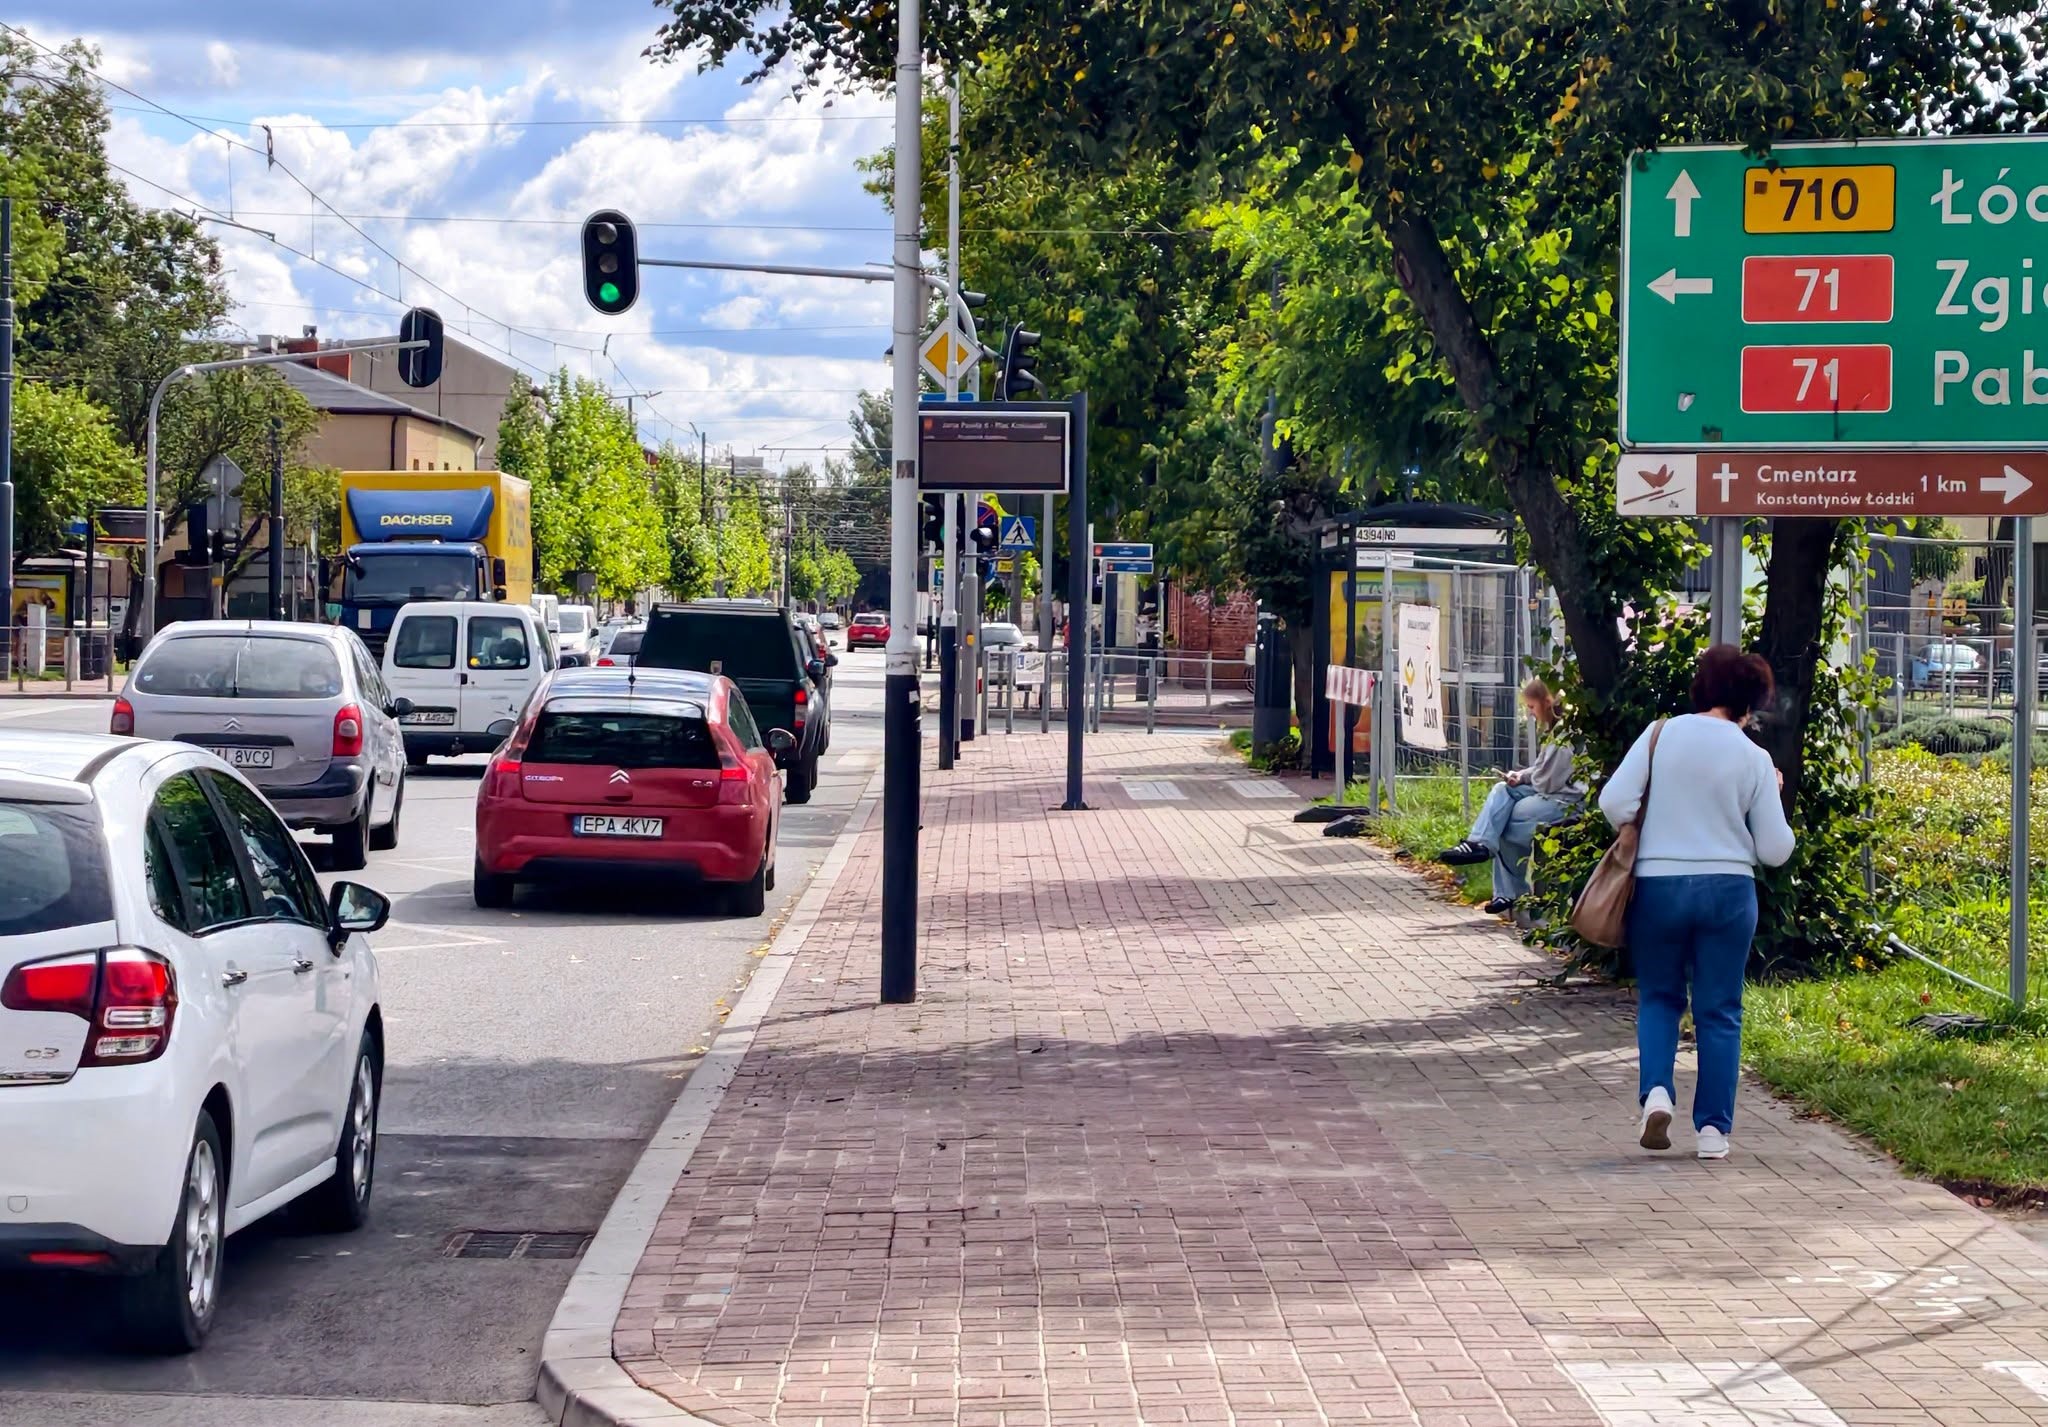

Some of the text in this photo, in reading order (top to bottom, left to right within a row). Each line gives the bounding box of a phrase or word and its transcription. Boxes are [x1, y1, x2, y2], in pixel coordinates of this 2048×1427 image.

[1779, 178, 1859, 221] 710
[1794, 268, 1840, 312] 71
[1935, 258, 2048, 333] Zgi
[1792, 358, 1840, 402] 71
[1934, 349, 2048, 406] Pab
[1757, 465, 1857, 483] Cmentarz
[1920, 474, 1967, 493] 1 km
[1757, 492, 1915, 508] Konstantynów Łódzki
[380, 514, 453, 527] DACHSER
[235, 750, 270, 764] 8VC9
[583, 817, 661, 834] EPA 4KV7
